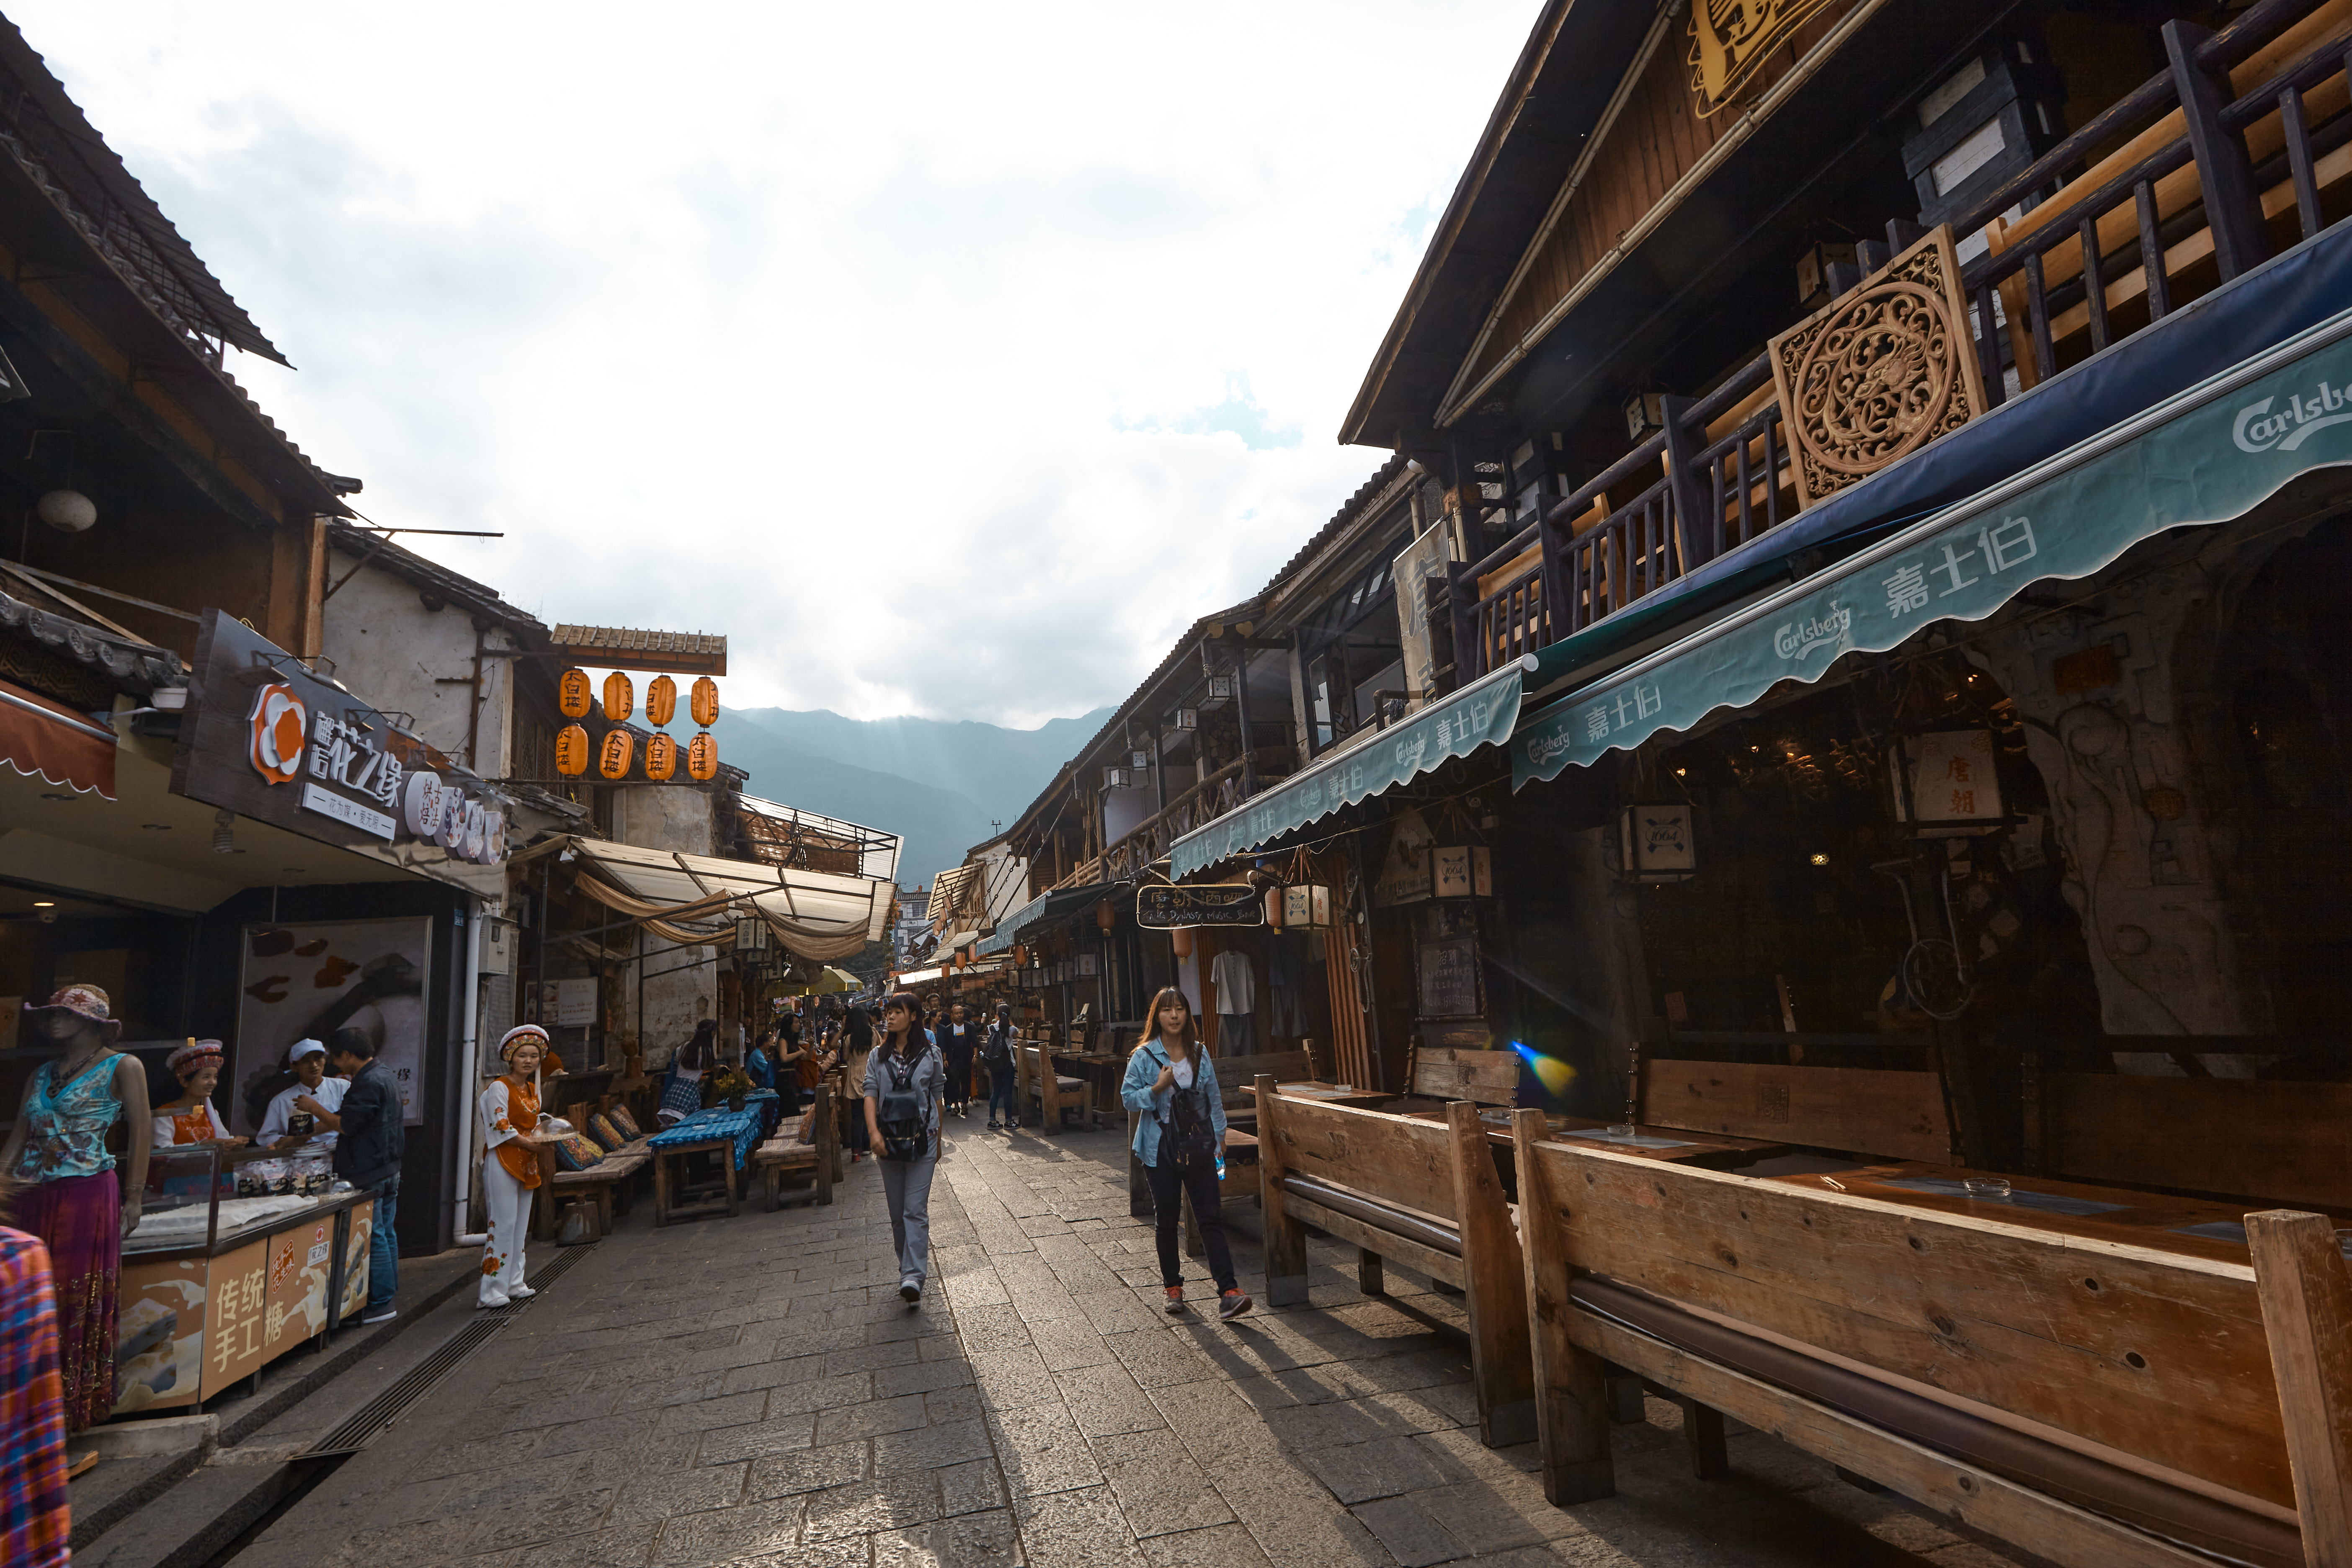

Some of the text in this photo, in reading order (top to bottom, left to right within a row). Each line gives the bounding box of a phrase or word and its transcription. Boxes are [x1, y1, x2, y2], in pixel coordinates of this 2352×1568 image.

[1882, 516, 2037, 619] 嘉士伯
[1774, 607, 1851, 660] Carlsberg
[1436, 700, 1488, 750] 嘉士伯
[1585, 683, 1662, 743] 嘉士伯
[1396, 735, 1425, 765] Carlsberg
[1527, 729, 1570, 764] Carlsberg
[419, 779, 433, 825] 烘焙
[1329, 765, 1363, 801] 嘉士伯
[1946, 756, 1976, 815] 唐朝
[431, 784, 442, 829] 古法
[1251, 809, 1276, 836] 嘉士伯
[1651, 830, 1677, 842] 1664
[1445, 866, 1463, 874] 1664
[1207, 910, 1233, 920] MUSIC
[1291, 900, 1304, 910] 1664
[393, 1068, 411, 1081] 缘
[217, 1268, 265, 1328] 传统
[213, 1301, 284, 1373] 手工糖
